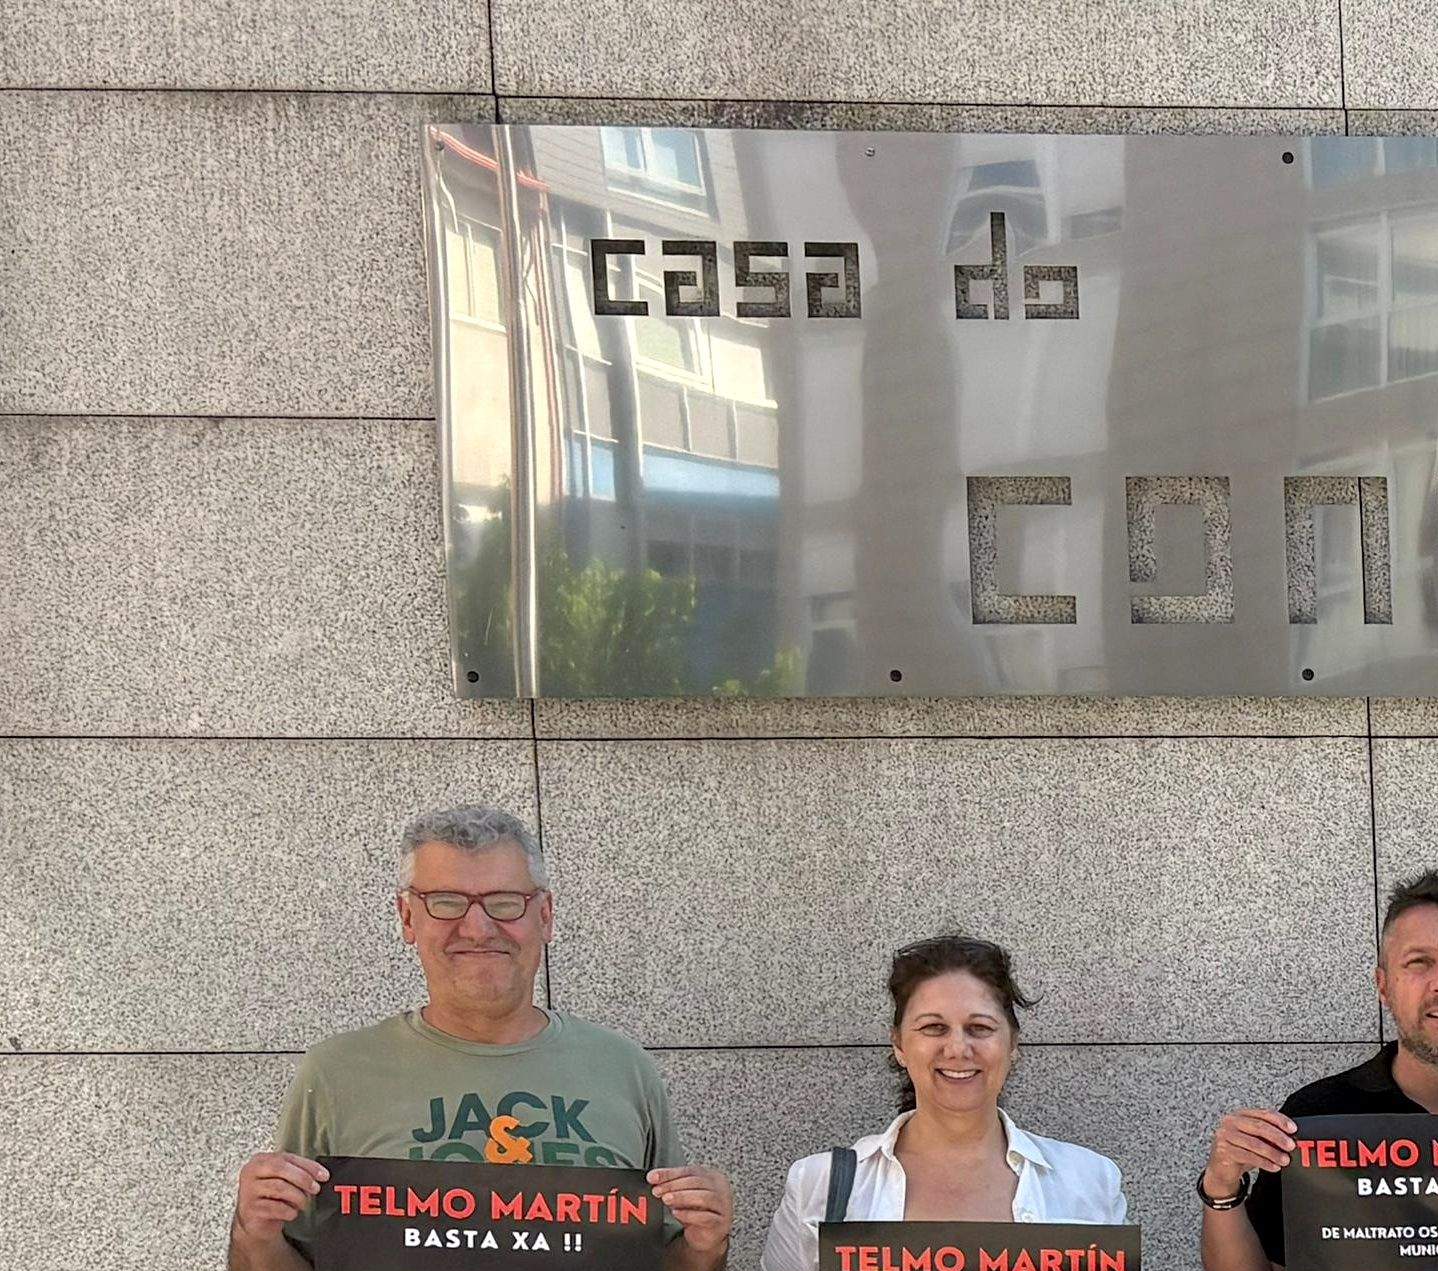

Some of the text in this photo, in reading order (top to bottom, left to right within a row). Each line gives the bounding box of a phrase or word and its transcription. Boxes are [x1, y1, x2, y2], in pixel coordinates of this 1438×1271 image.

[411, 1091, 597, 1143] JACK
[1294, 1139, 1421, 1169] TELMO
[334, 1185, 649, 1226] TELMO MARTÍN
[404, 1227, 499, 1250] BASTA
[512, 1231, 551, 1251] XA
